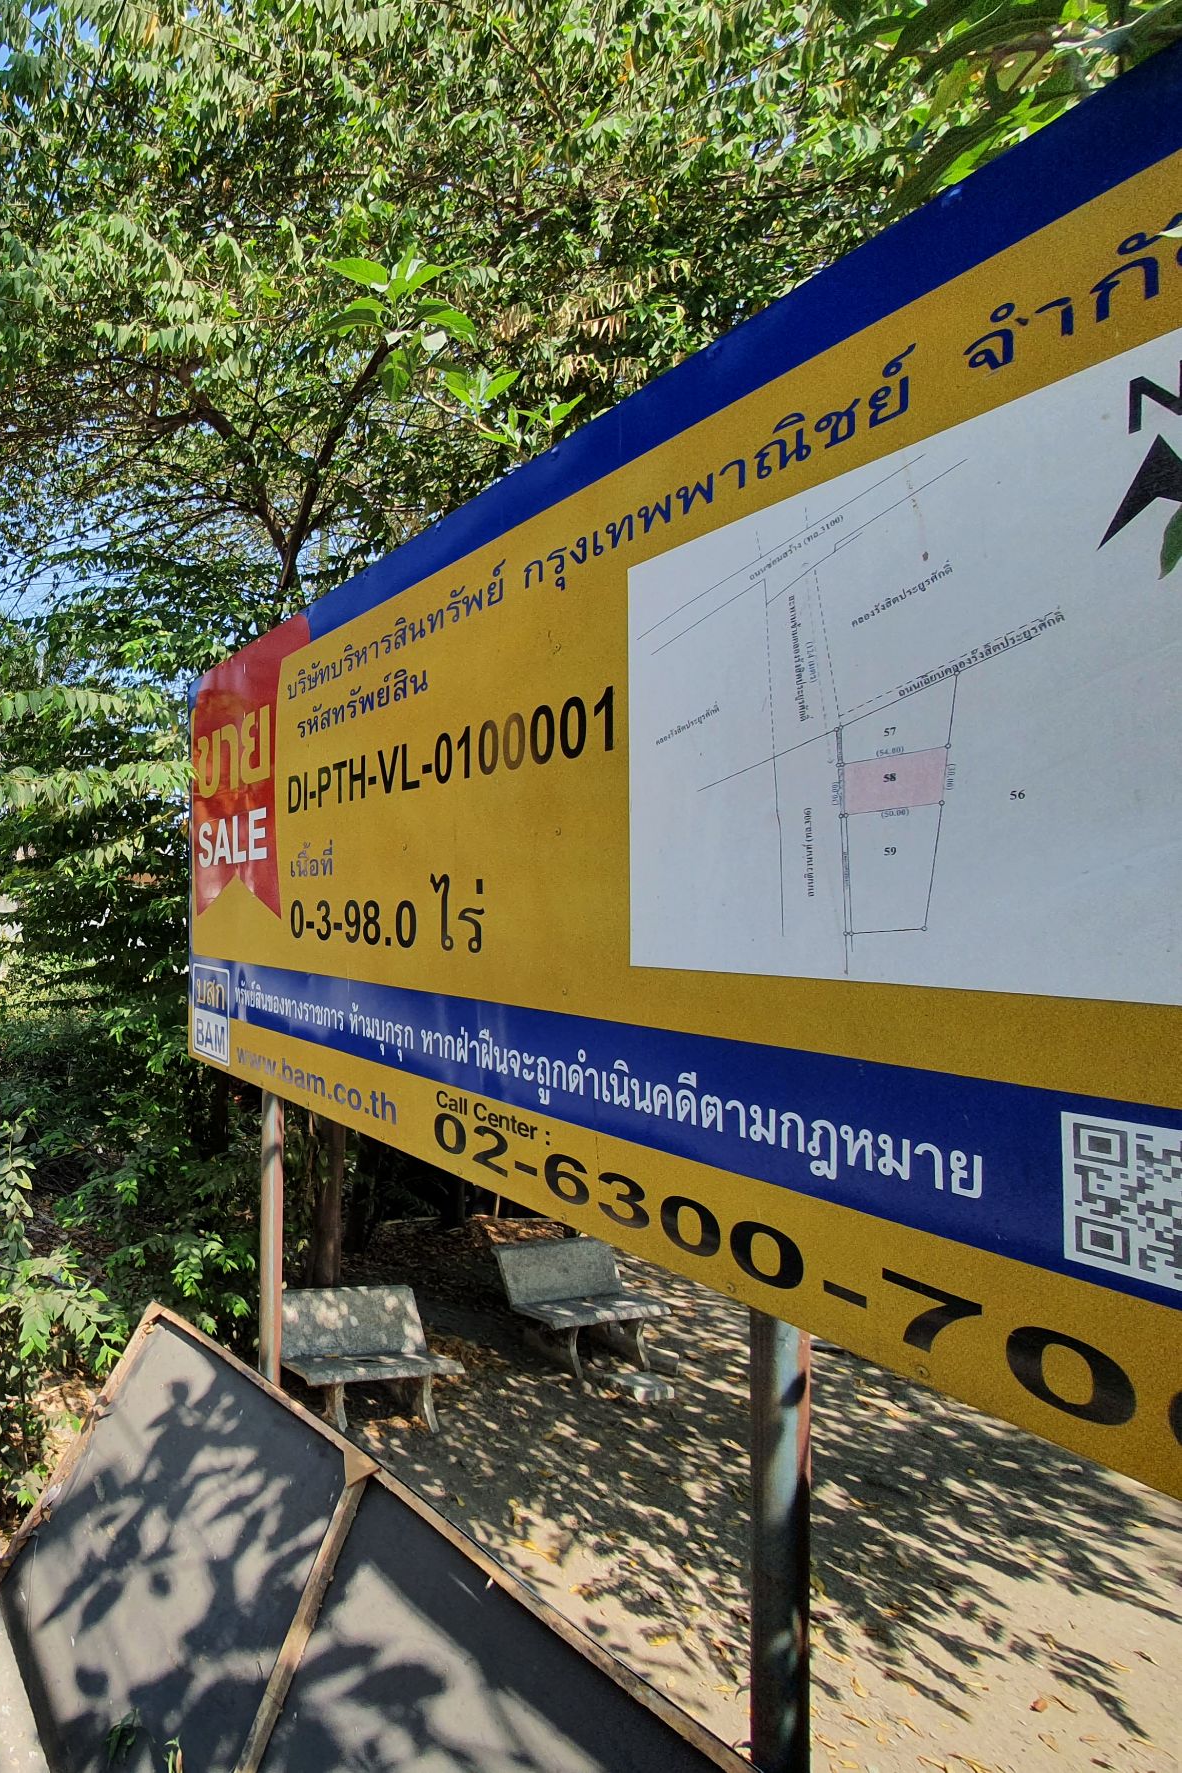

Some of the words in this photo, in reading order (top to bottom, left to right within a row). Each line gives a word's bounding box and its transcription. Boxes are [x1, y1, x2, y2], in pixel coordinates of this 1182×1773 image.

[287, 558, 507, 700] บริษัทบริหารสินทรัพย์
[524, 343, 918, 591] กรุงเทพพาณิชย์
[963, 213, 1182, 372] จำกั
[297, 669, 429, 738] รหัสทรัพย์สิน
[883, 727, 897, 737] 57
[197, 704, 271, 798] ขาย
[287, 686, 616, 814] DI-PTH-VL-0100001
[883, 773, 897, 783] 58
[1009, 789, 1026, 800] 56
[198, 807, 268, 868] SALE
[290, 839, 334, 877] เนื้อที่
[883, 847, 897, 856] 59
[290, 900, 417, 948] 0-3-98.0
[429, 873, 486, 953] ไร่
[196, 977, 226, 1010] บสก
[196, 1017, 226, 1057] BAM
[234, 979, 345, 1032] ทรัพย์สินของทางราชการ
[348, 1002, 415, 1063] ห้ามบุกรุก
[420, 1025, 983, 1199] หากฝ่าฝืนจะถูกดำเนินคดีตามกฎหมาย
[235, 1047, 398, 1126] www.bam.co.th
[436, 1089, 468, 1117] Call
[473, 1102, 538, 1140] Center
[433, 1113, 1182, 1448] 02-6300-70
